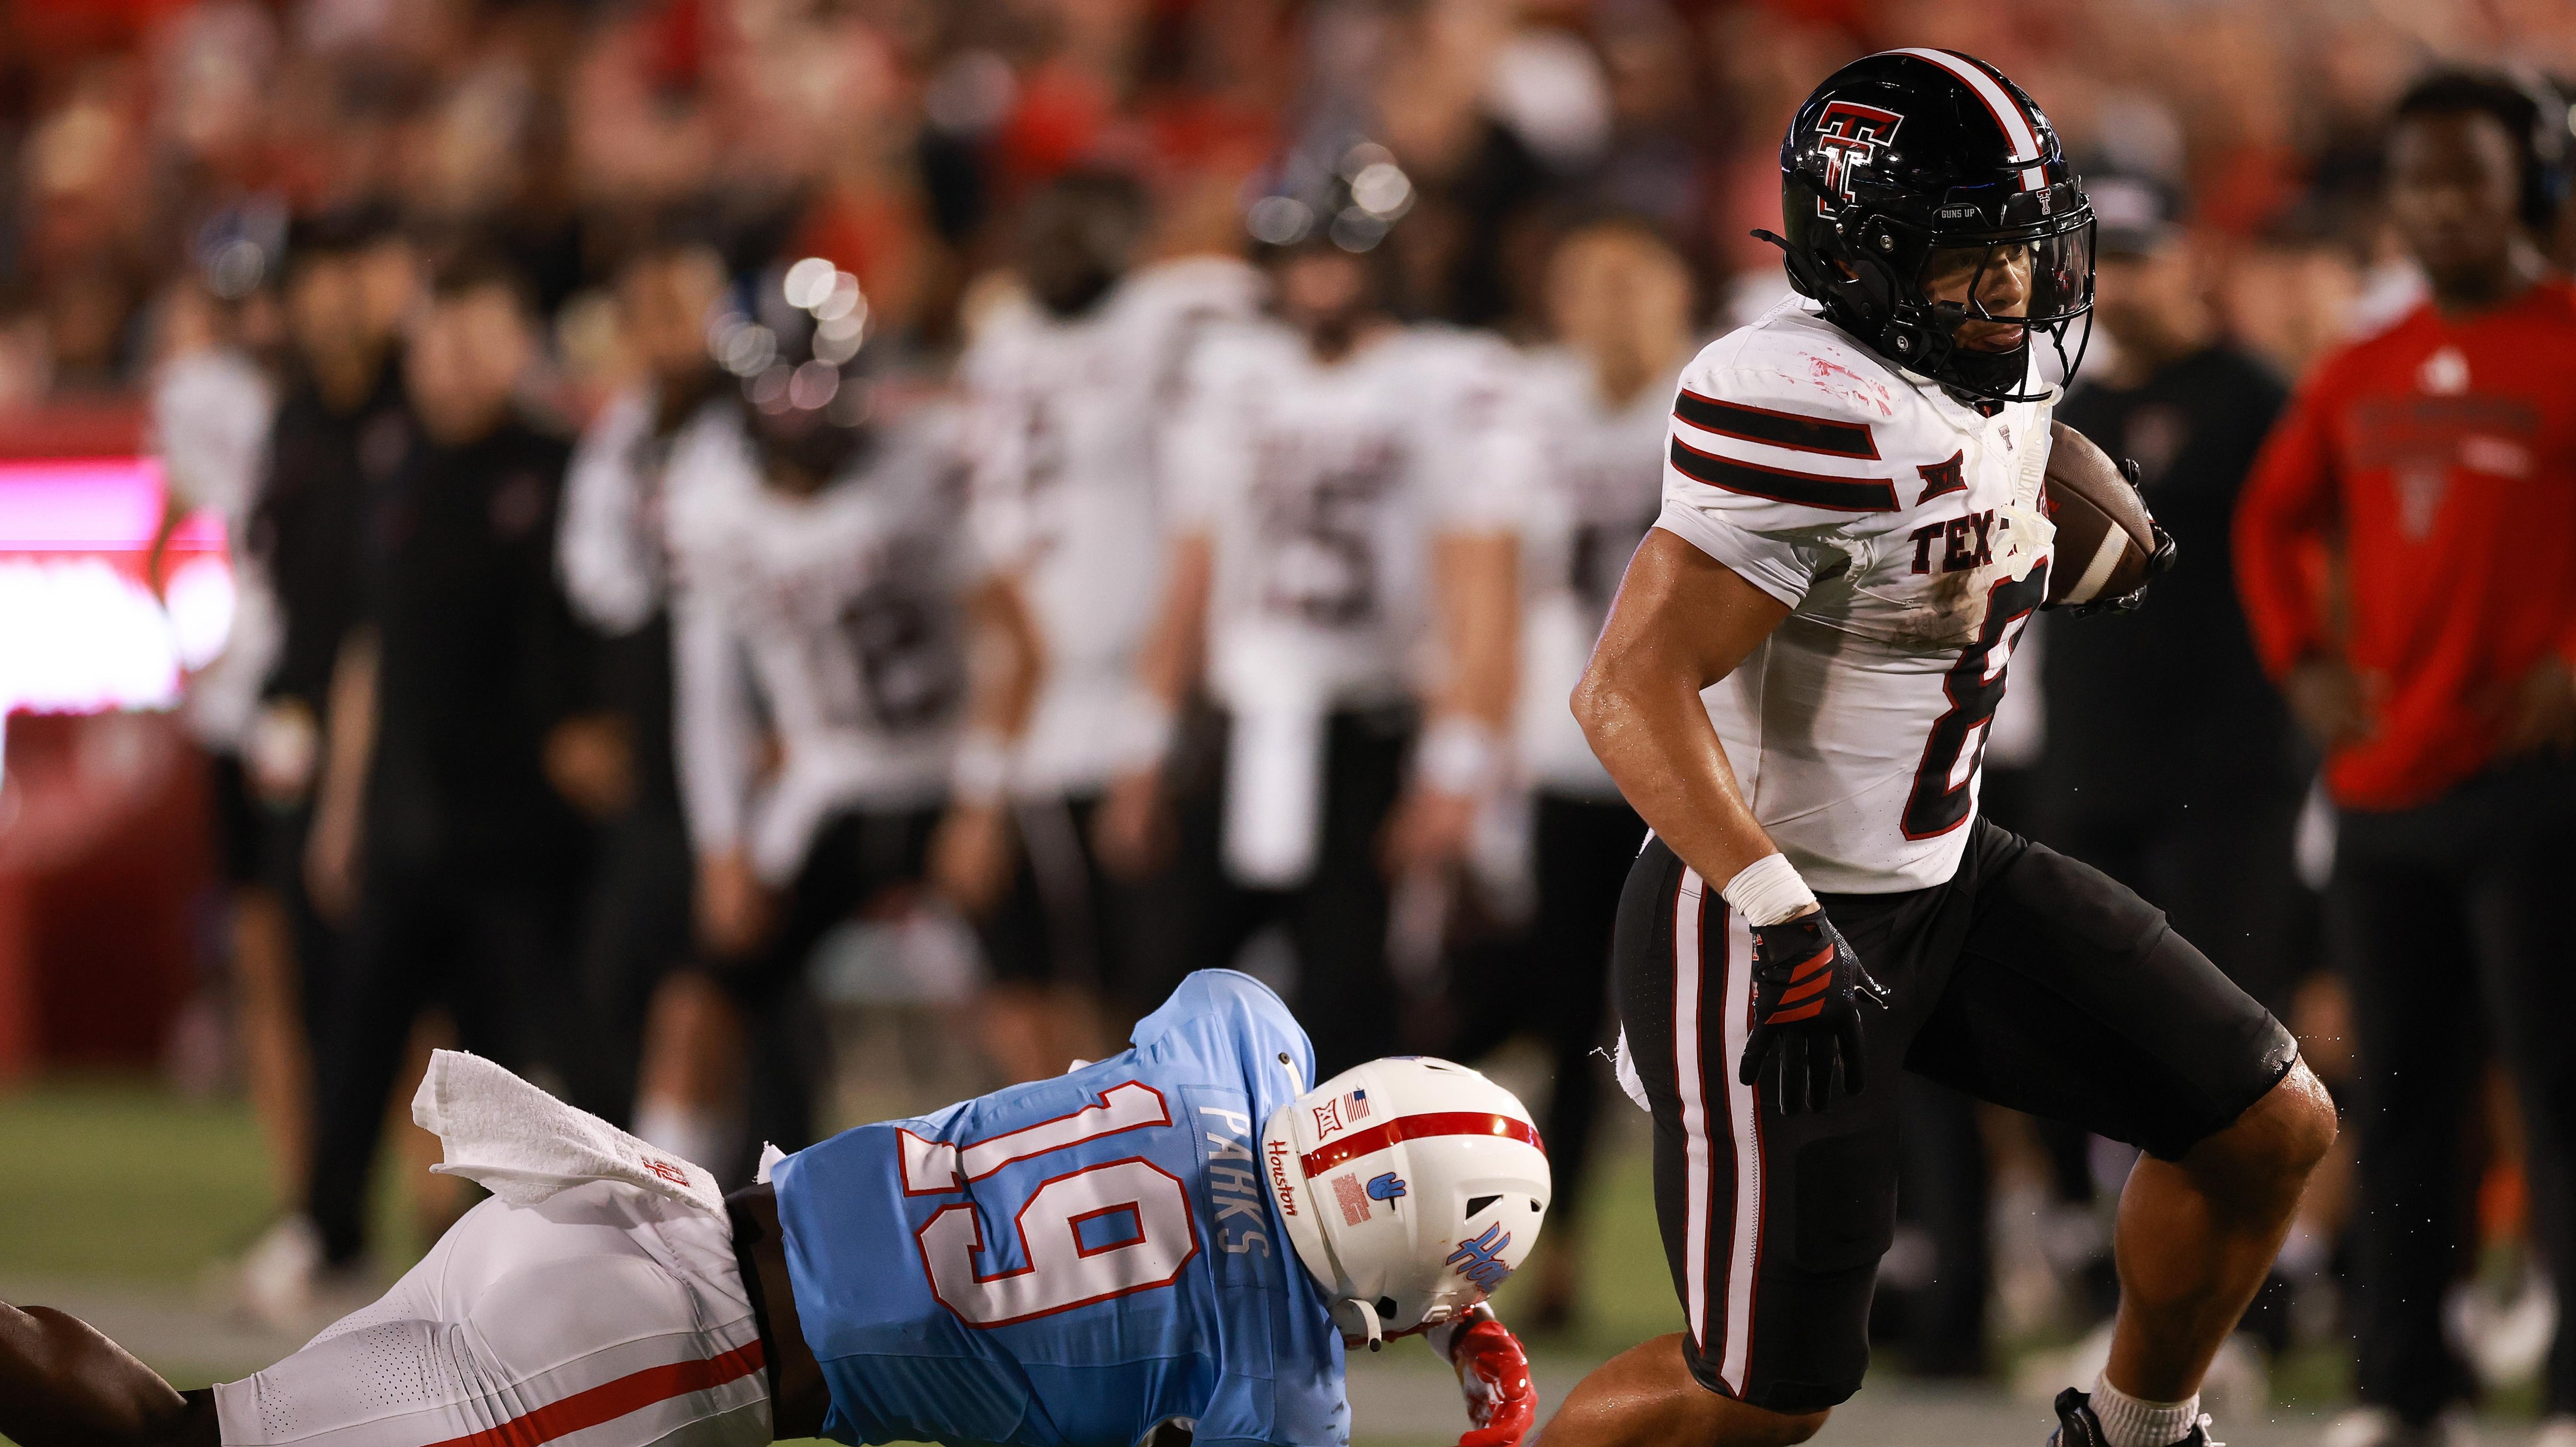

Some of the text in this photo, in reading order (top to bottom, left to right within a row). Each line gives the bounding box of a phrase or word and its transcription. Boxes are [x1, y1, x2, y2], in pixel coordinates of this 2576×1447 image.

[1941, 208, 1975, 218] GUNS UP
[1907, 508, 2018, 574] TEX
[1901, 555, 2048, 841] 8
[895, 1080, 1199, 1330] 19
[1199, 1106, 1270, 1258] PARKS
[1267, 1139, 1298, 1216] Houston
